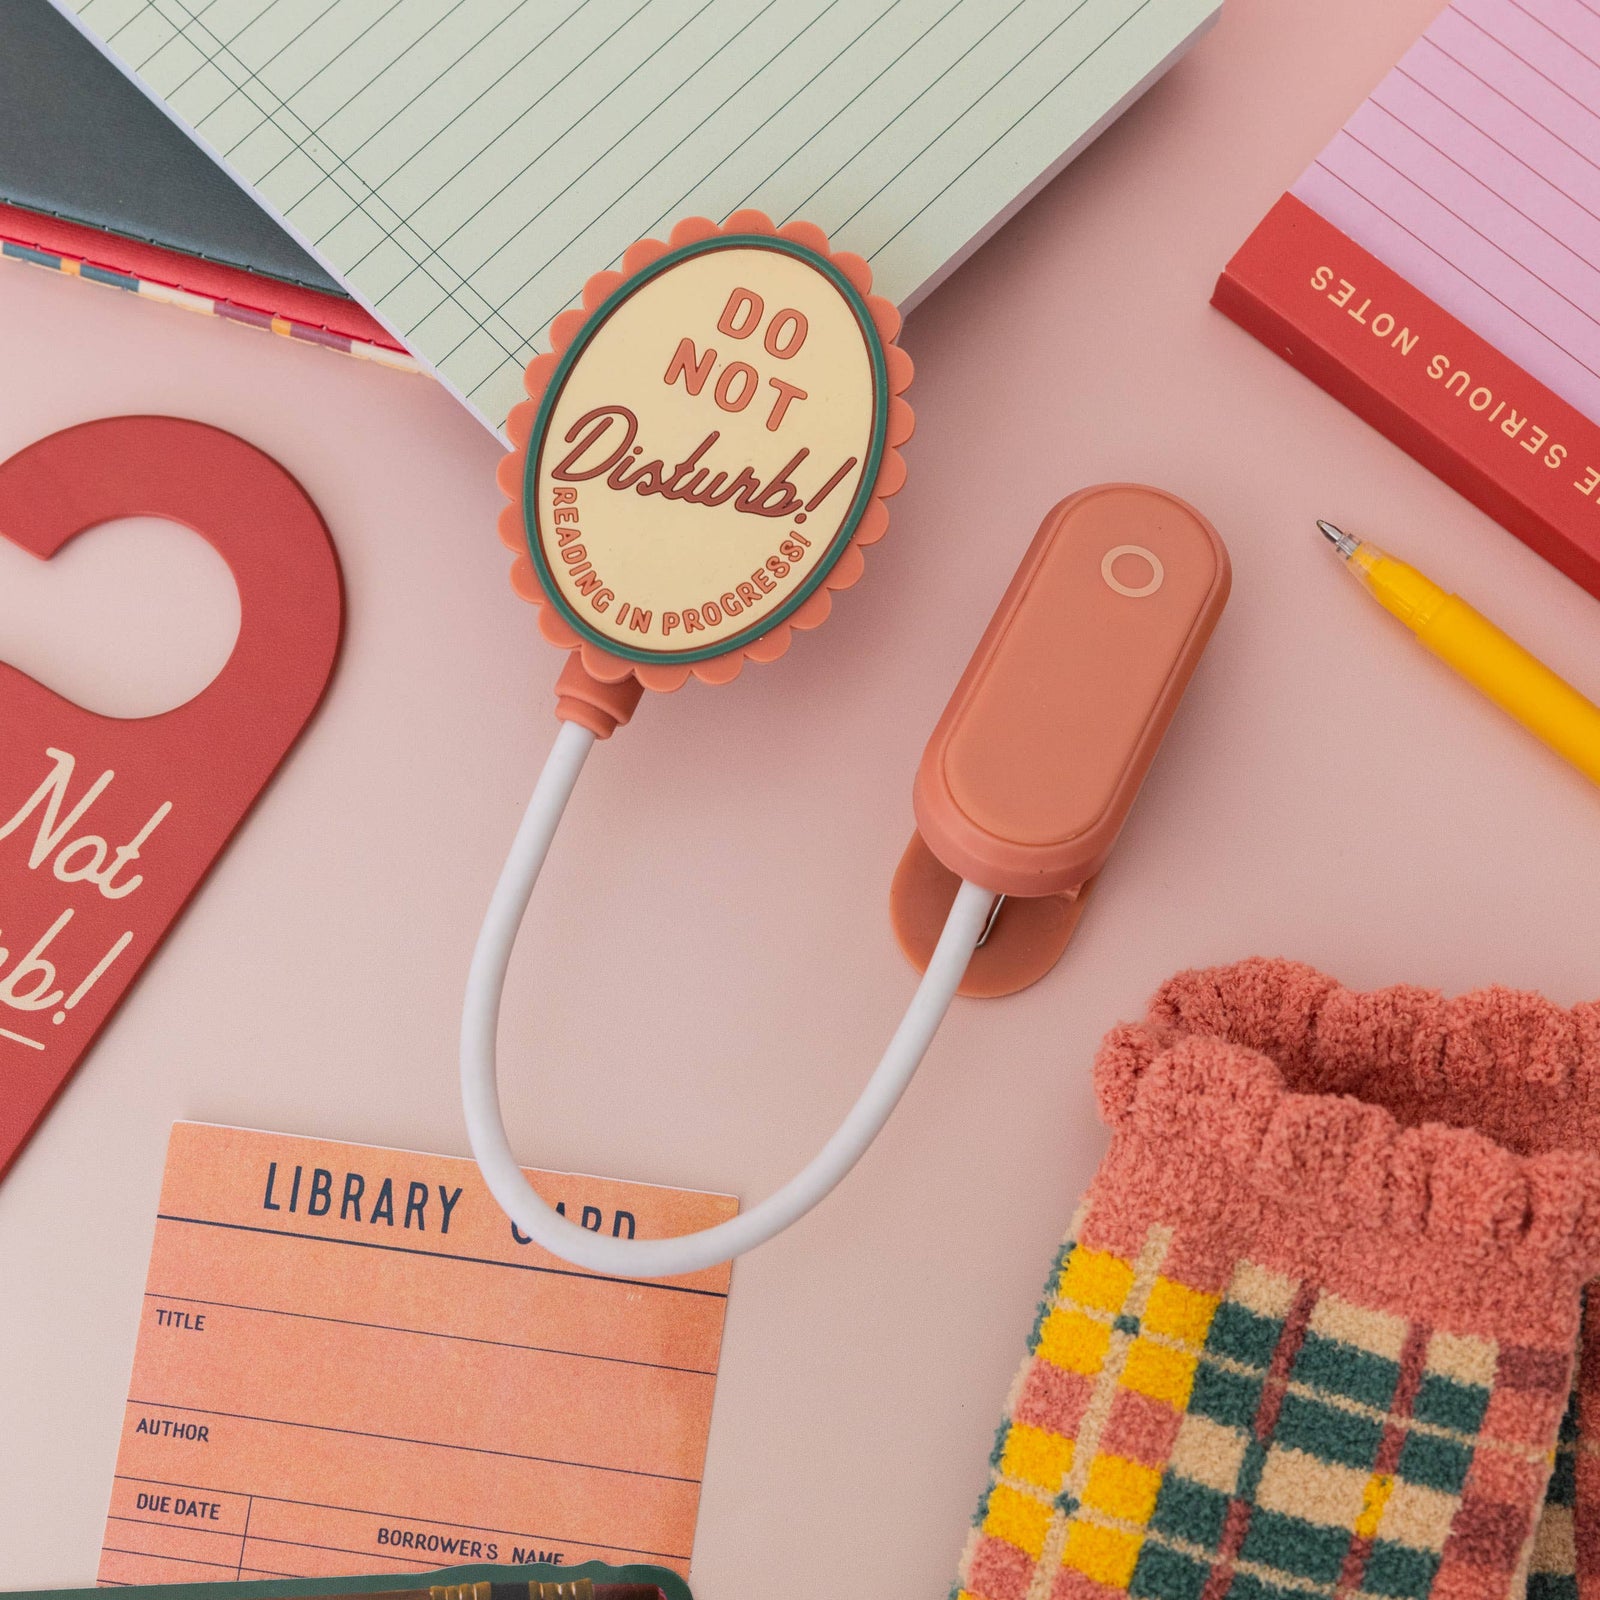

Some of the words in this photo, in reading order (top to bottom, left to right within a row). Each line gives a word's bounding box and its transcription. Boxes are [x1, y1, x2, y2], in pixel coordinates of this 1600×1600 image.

[717, 287, 809, 360] DO
[1310, 265, 1419, 356] NOTES
[663, 337, 808, 432] NOT
[1427, 353, 1568, 469] SERIOUS
[551, 405, 857, 524] Disturb!
[552, 486, 615, 614] READING
[615, 602, 652, 634] IN
[662, 530, 812, 636] PROGRESS!
[0, 747, 173, 899] Not
[263, 1162, 463, 1234] LIBRARY
[156, 1309, 206, 1331] TITLE
[136, 1418, 209, 1442] AUTHOR
[137, 1493, 171, 1513] DUE
[174, 1499, 221, 1520] DATE
[377, 1528, 499, 1560] BORROWER'S
